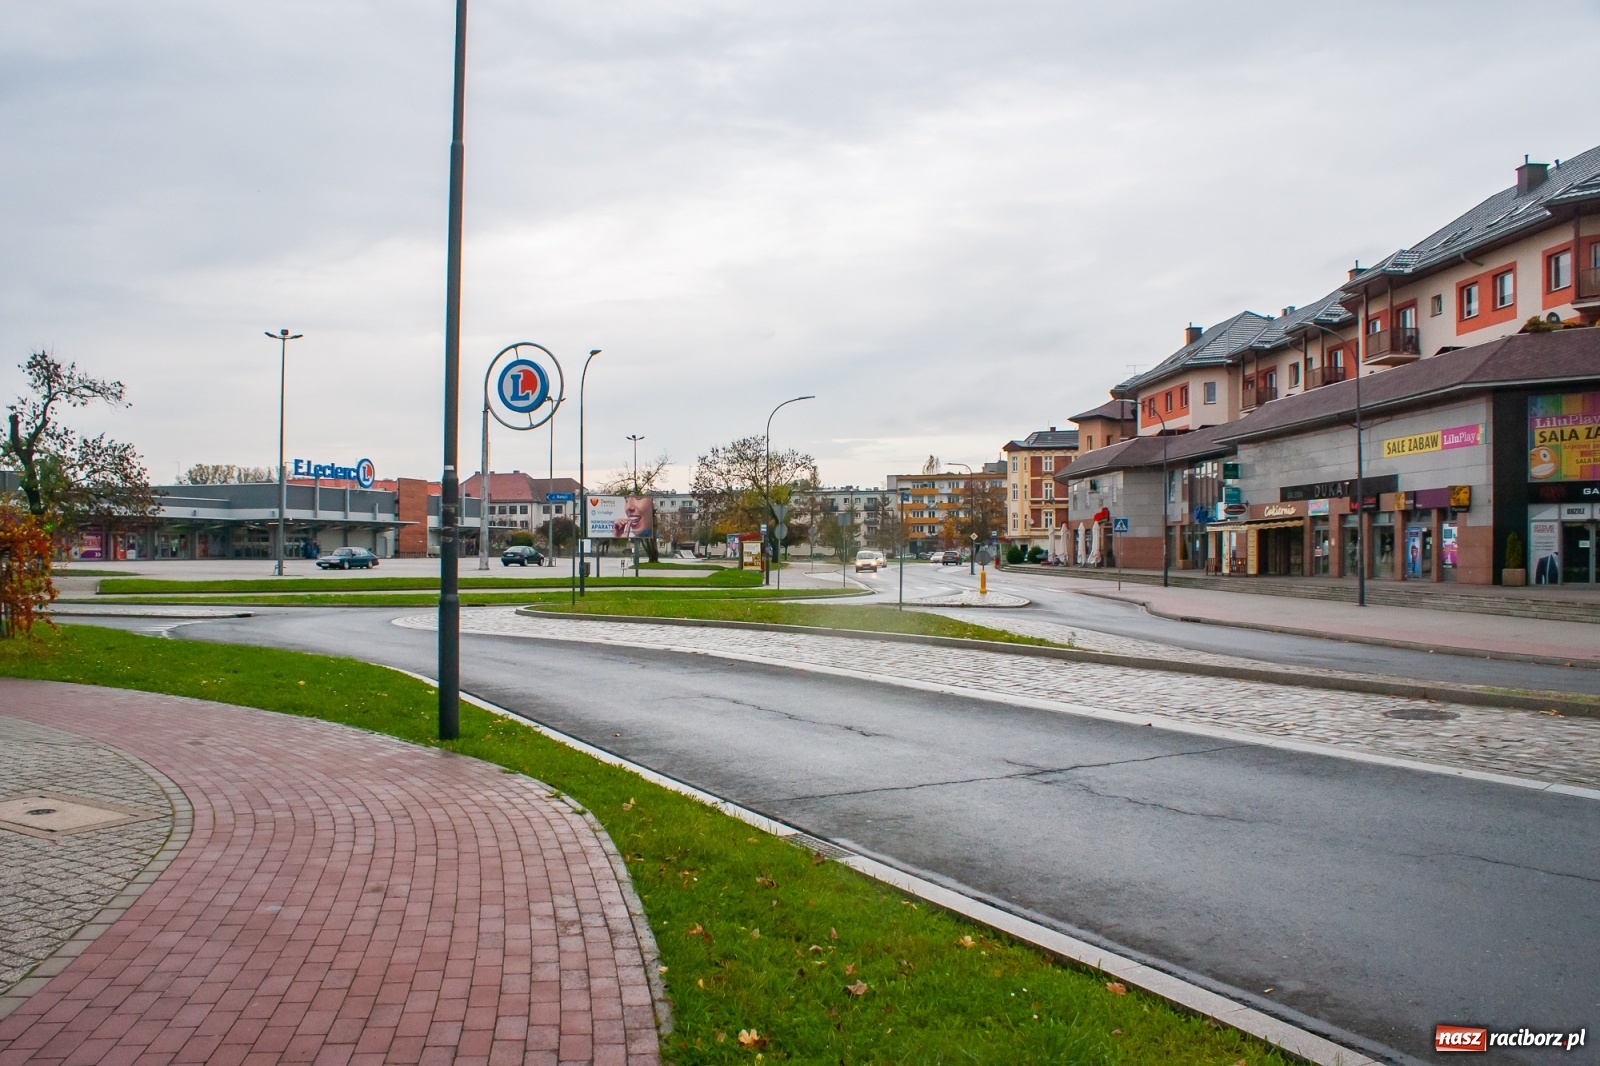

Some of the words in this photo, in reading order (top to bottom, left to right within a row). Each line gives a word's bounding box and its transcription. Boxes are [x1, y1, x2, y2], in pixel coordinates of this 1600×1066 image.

[510, 374, 531, 401] L
[1386, 439, 1406, 455] SALE
[1408, 433, 1439, 452] ZABAW
[1443, 431, 1476, 446] LiluPlay
[1538, 427, 1579, 444] SALA
[294, 458, 357, 480] E.Leclerc
[1314, 482, 1350, 498] DUKAT
